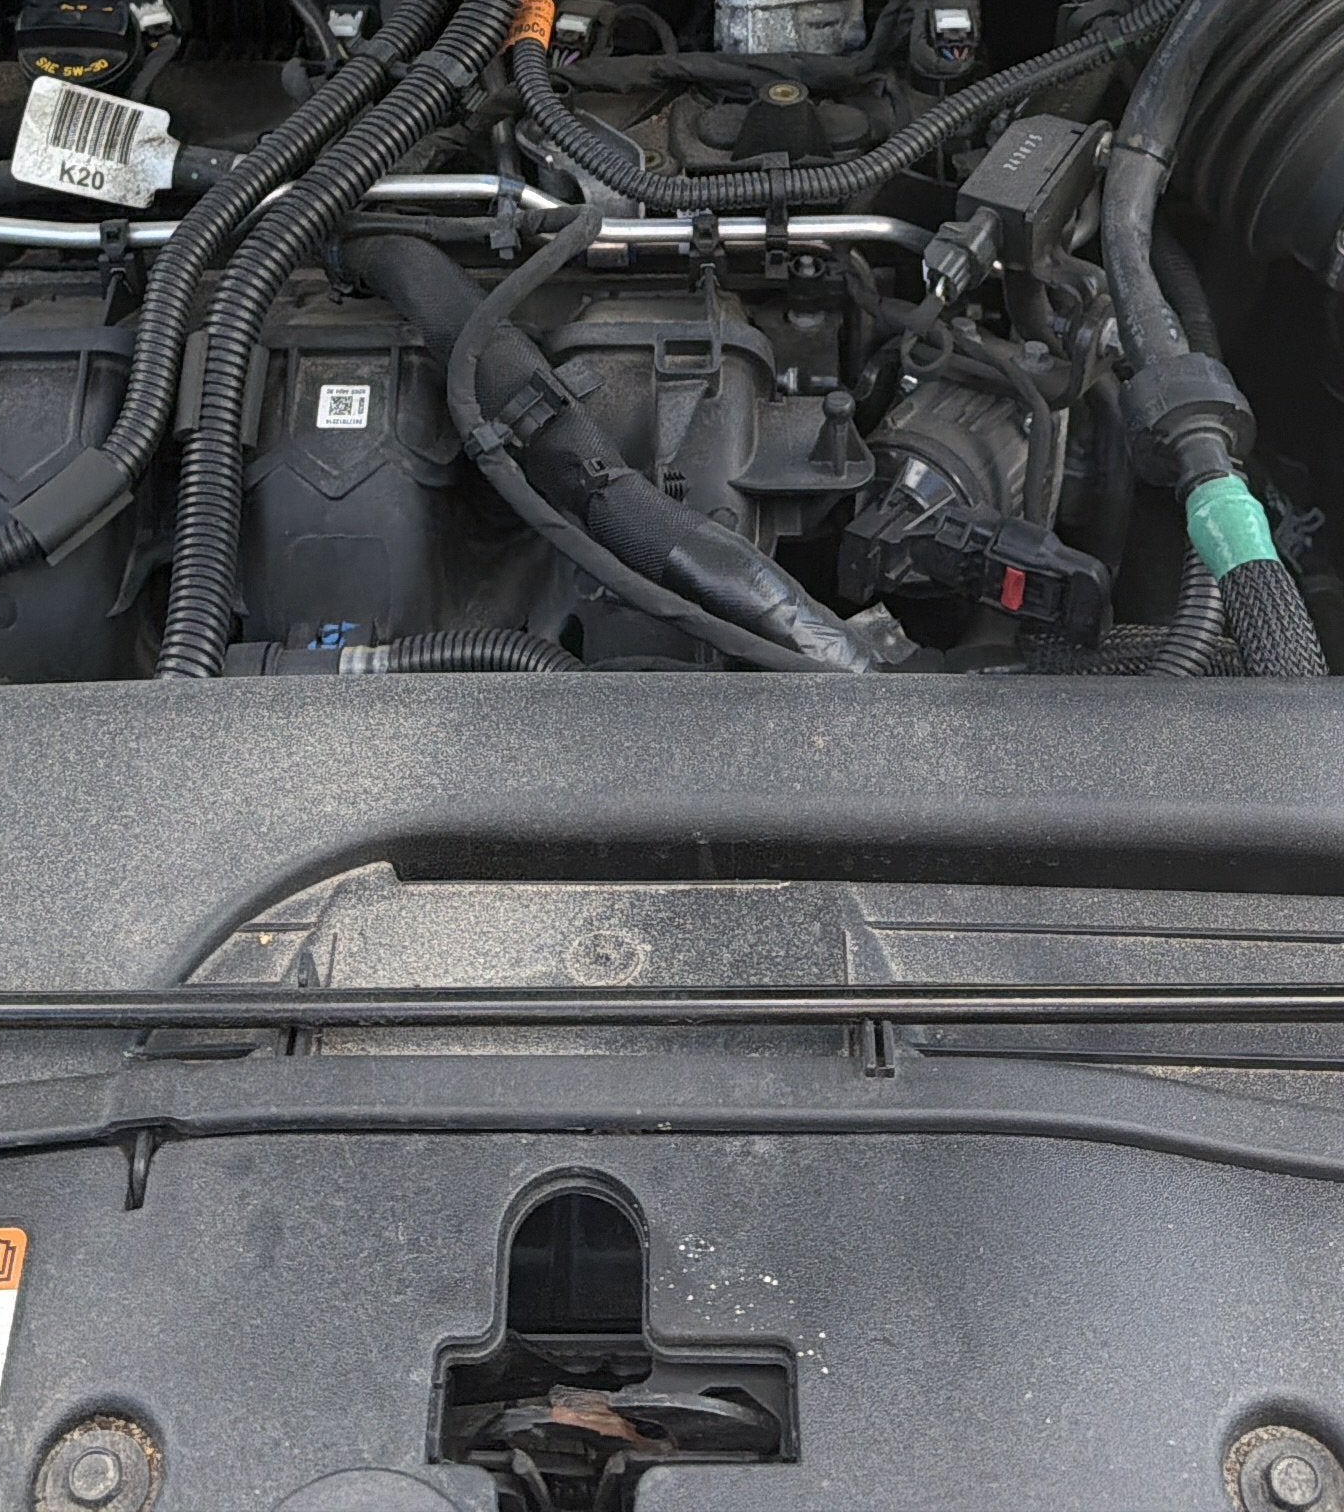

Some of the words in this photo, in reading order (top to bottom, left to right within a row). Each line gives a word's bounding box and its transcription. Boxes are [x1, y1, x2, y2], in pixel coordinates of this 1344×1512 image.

[35, 56, 59, 75] SAE
[62, 58, 110, 77] 5W-30
[58, 160, 105, 190] K20
